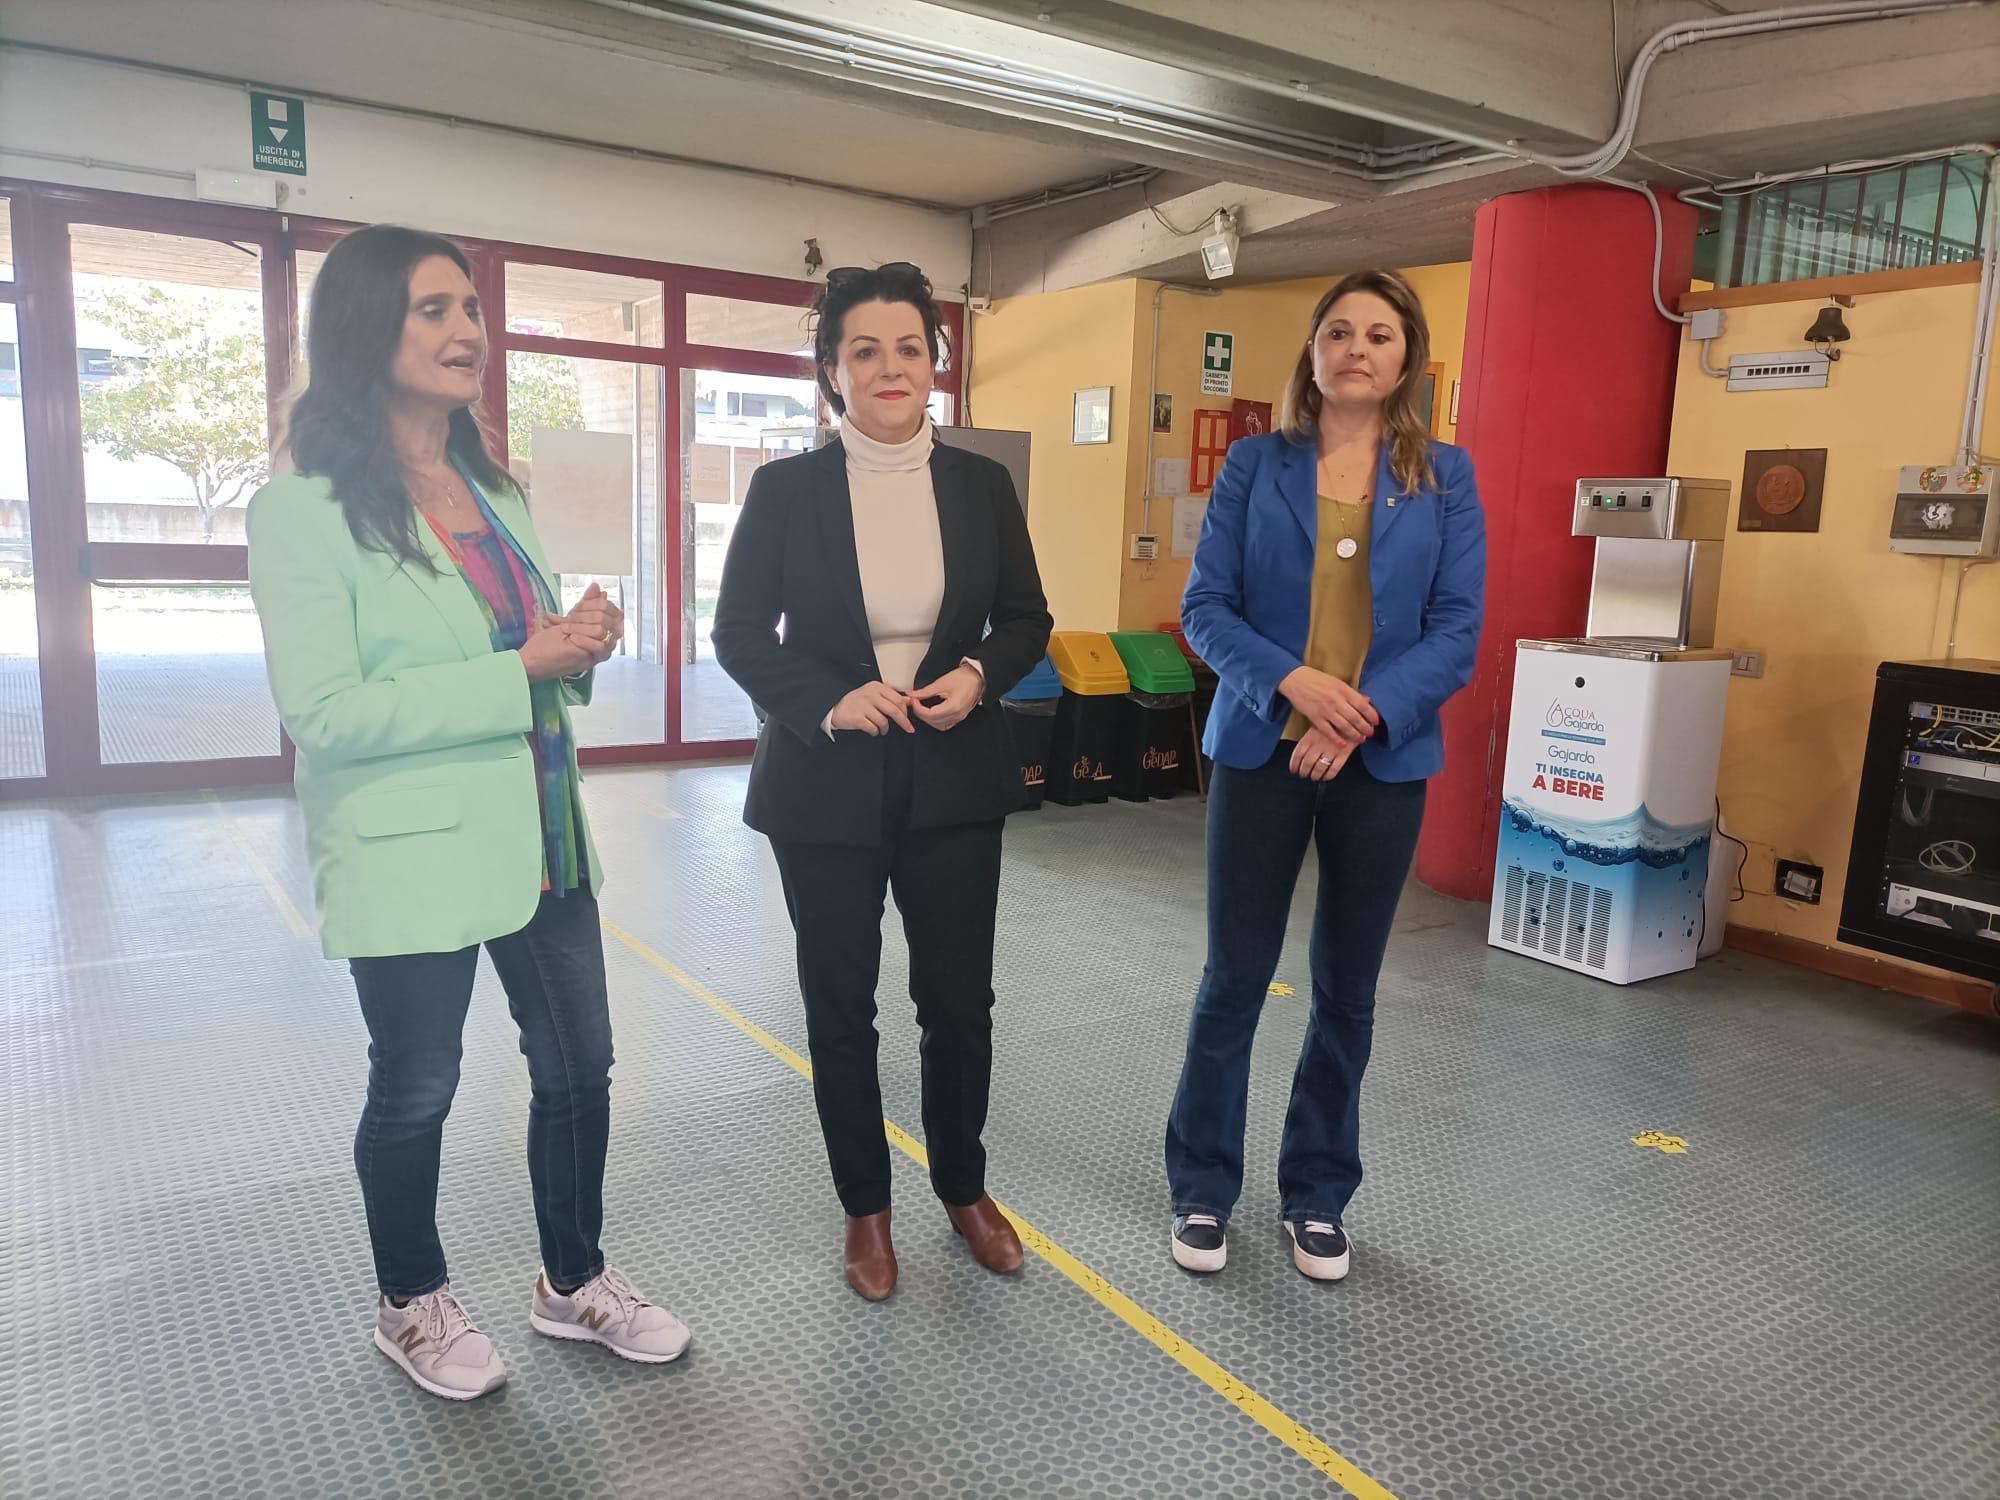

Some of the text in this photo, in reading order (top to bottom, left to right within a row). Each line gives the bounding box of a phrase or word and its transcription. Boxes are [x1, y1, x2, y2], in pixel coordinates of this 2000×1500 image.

[259, 145, 300, 159] USCITA DI
[255, 154, 305, 169] EMERGENZA
[1553, 703, 1596, 720] ACQUA
[1563, 716, 1604, 732] Gajarda
[1548, 745, 1595, 764] Gajarda
[1535, 762, 1604, 784] TI INSEGNA
[1532, 774, 1605, 801] A BERE
